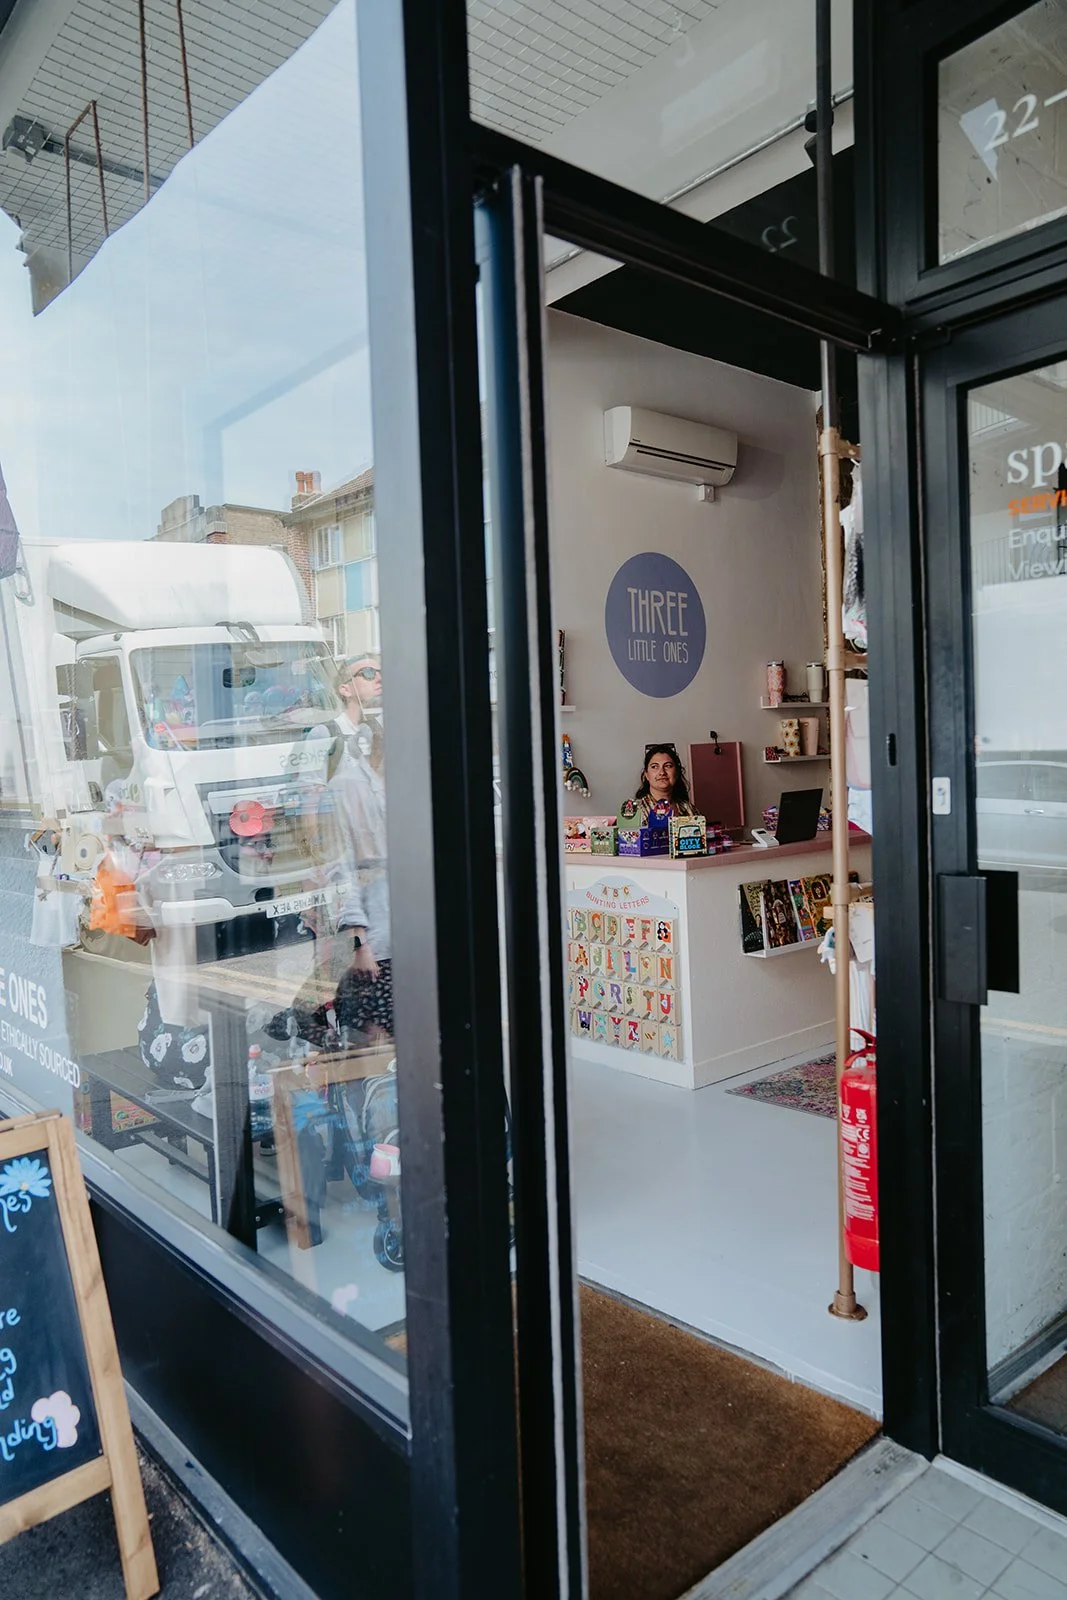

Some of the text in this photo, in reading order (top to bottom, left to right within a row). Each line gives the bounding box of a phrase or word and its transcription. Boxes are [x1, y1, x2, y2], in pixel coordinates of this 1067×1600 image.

[1007, 441, 1067, 488] sp
[627, 587, 688, 636] THREE
[628, 639, 689, 664] LITTLE ONES
[585, 891, 650, 909] BUNTING LETTERS
[8, 971, 48, 1030] ONES
[1, 1021, 80, 1089] ETHICALLY SOURCED
